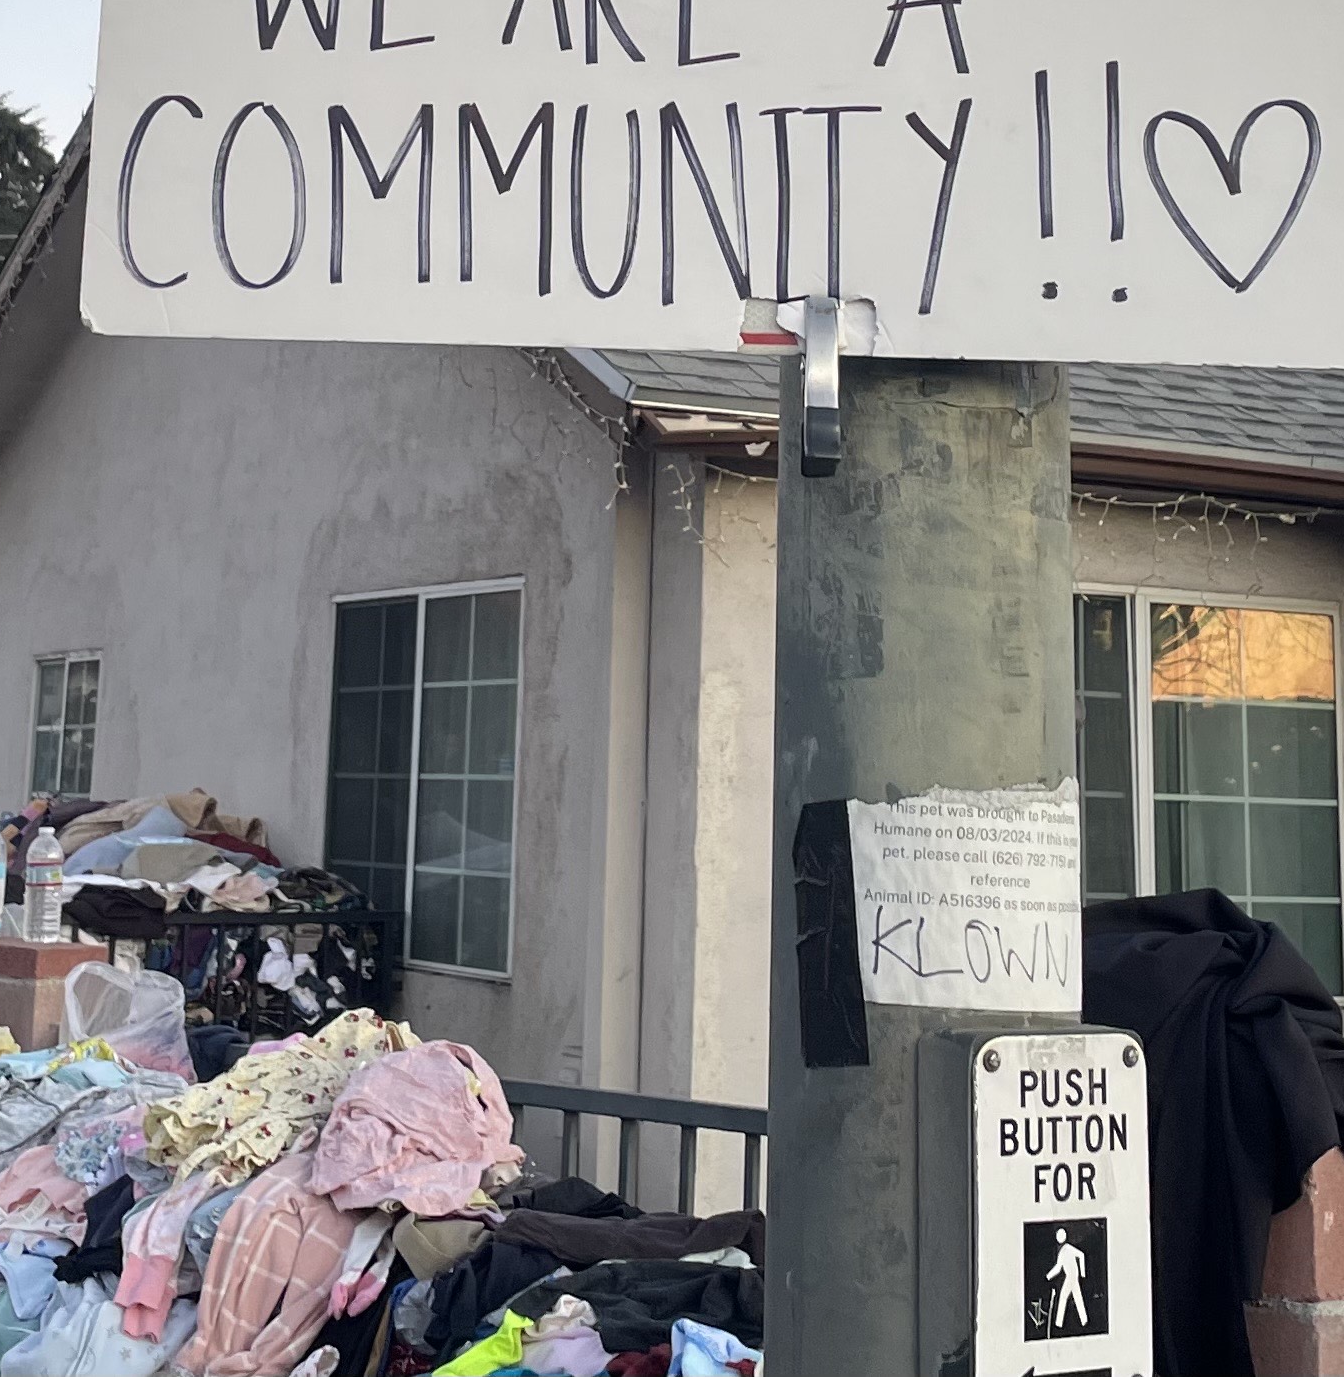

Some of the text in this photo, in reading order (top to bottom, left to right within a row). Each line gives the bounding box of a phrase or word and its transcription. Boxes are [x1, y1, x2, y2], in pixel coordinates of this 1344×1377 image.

[920, 803, 942, 817] pet
[947, 806, 974, 818] was
[1029, 810, 1039, 821] to
[874, 822, 932, 837] Humane
[935, 828, 952, 838] on
[956, 826, 1034, 843] 08/03/2024.
[1047, 832, 1062, 846] this
[914, 847, 960, 862] please
[963, 850, 988, 863] call
[992, 851, 1023, 866] (626)
[970, 873, 1031, 888] reference
[864, 888, 913, 904] Animal
[939, 893, 1000, 909] A516396
[1004, 900, 1017, 910] as
[1020, 900, 1045, 912] soon
[1047, 901, 1057, 912] as
[872, 905, 1068, 986] KLOWN
[1019, 1068, 1108, 1108] PUSH
[999, 1113, 1128, 1157] BUTTON
[1034, 1162, 1097, 1204] FOR
